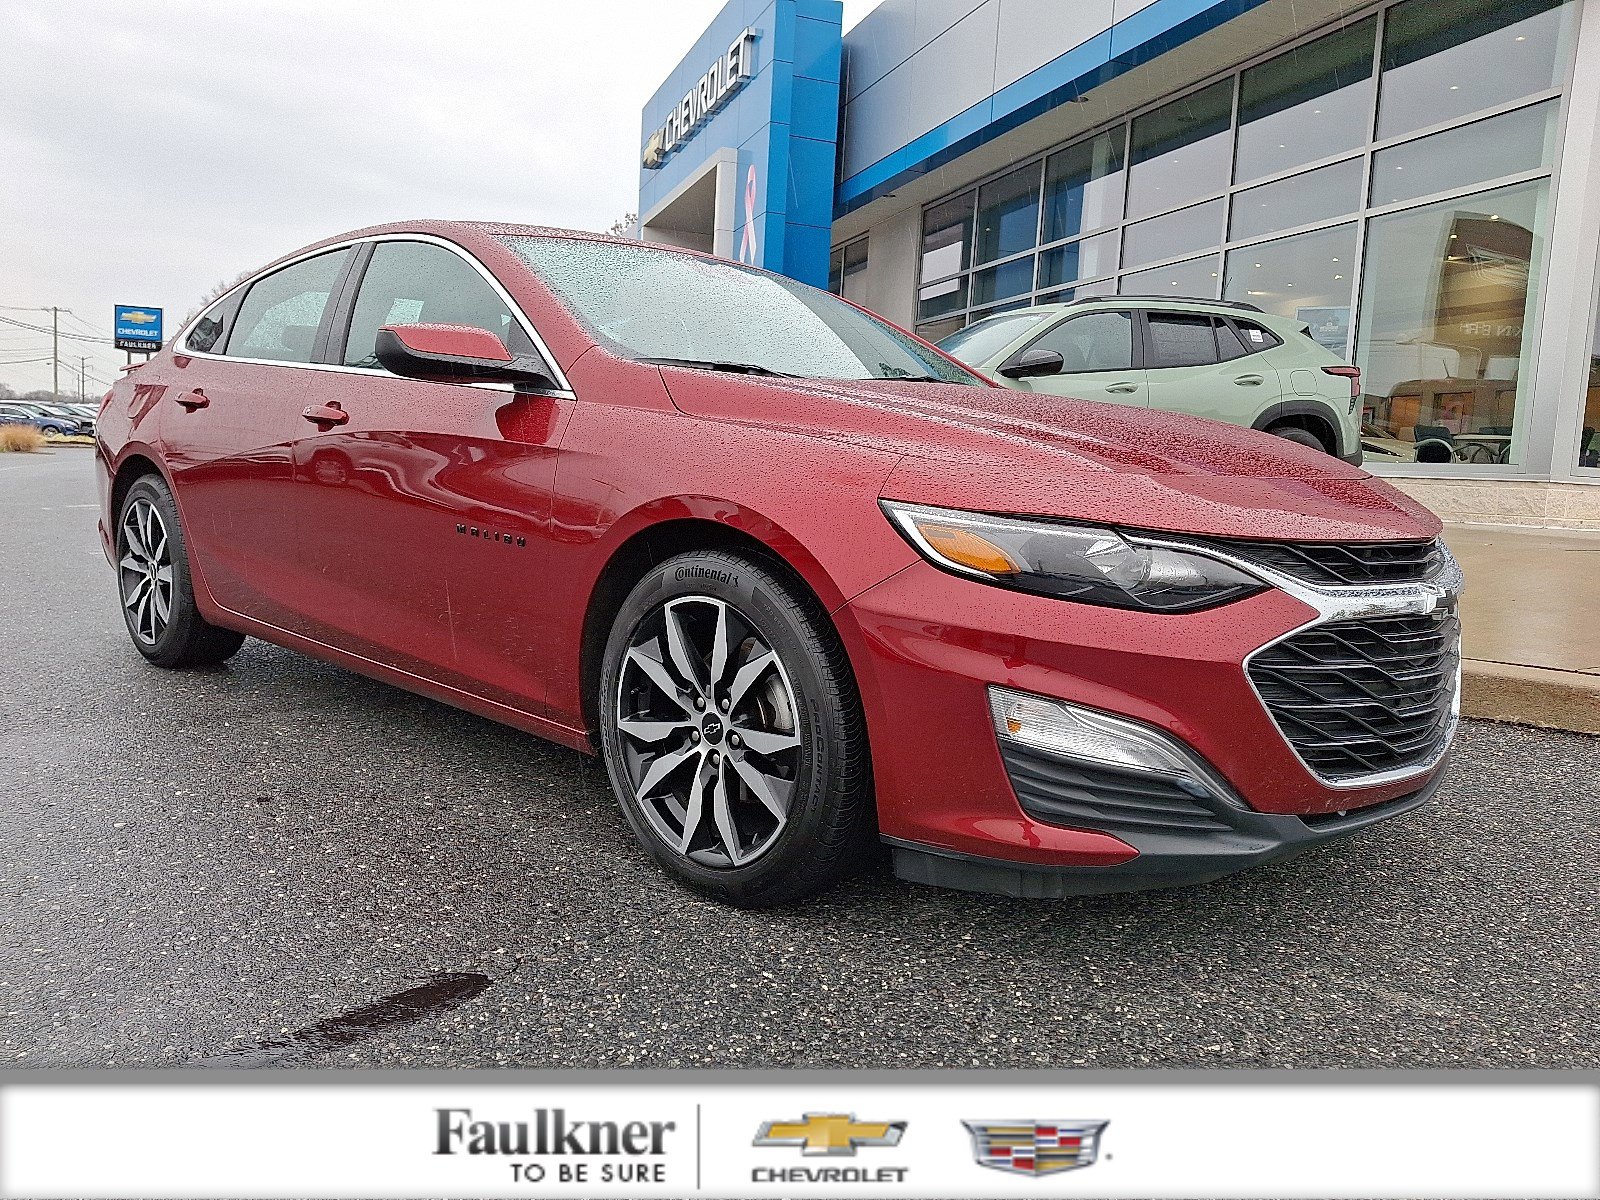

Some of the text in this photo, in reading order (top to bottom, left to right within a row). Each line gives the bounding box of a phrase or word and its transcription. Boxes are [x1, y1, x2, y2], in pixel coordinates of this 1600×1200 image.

[664, 26, 757, 152] CHEVROLET
[118, 327, 158, 337] CHEVROLET
[120, 341, 156, 349] FAULKNER
[456, 523, 526, 548] MALIBU
[674, 565, 733, 585] Continental
